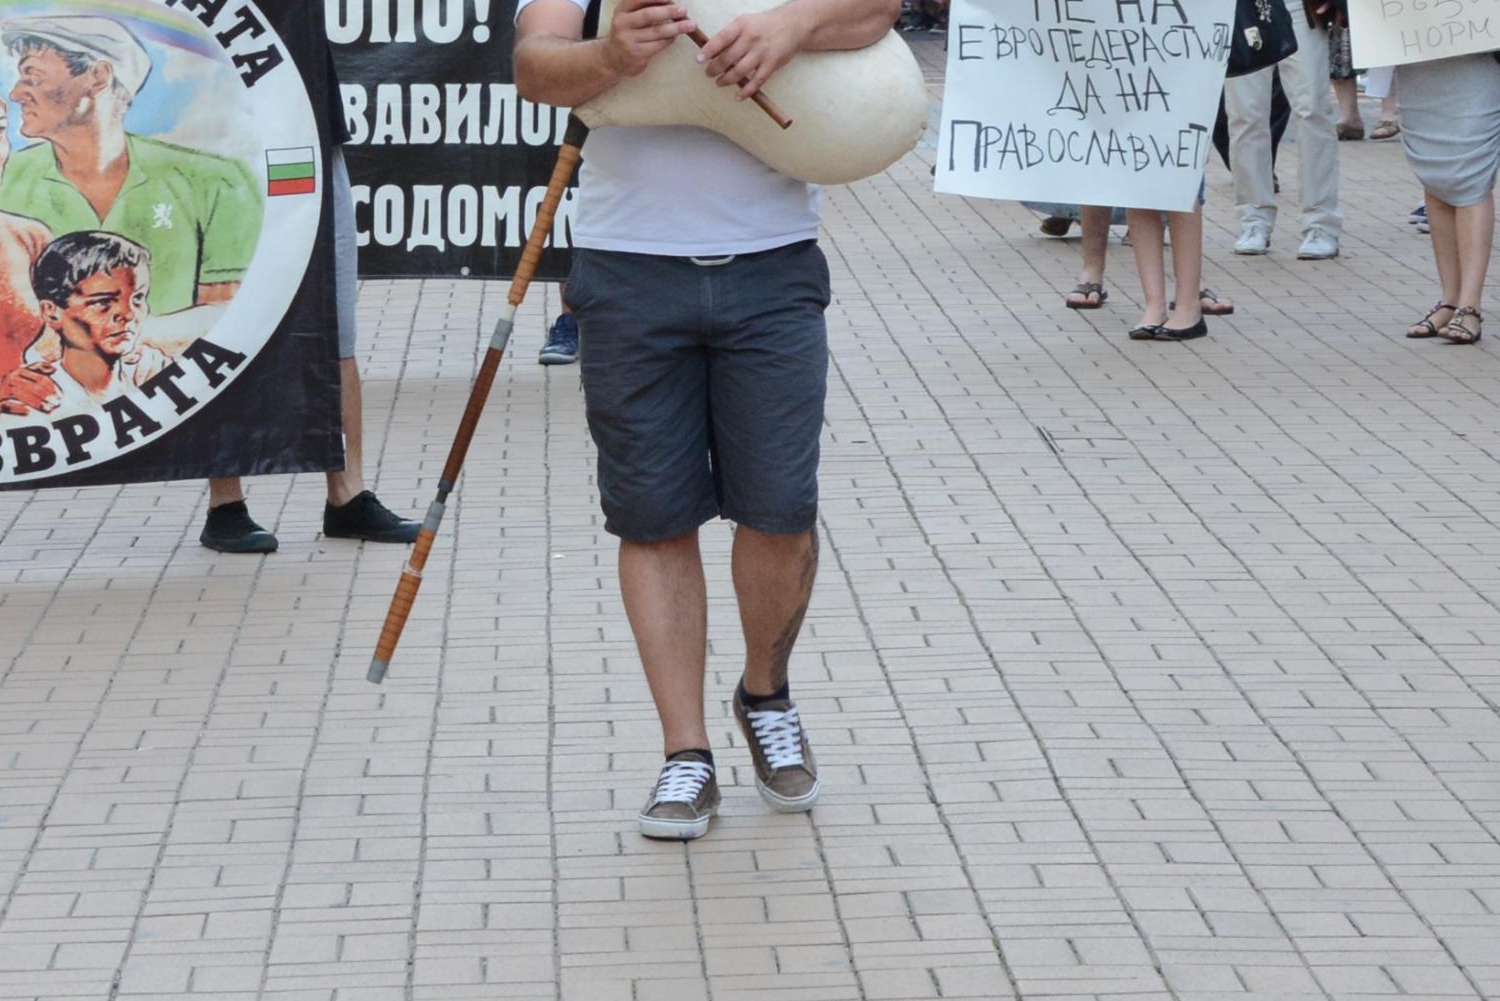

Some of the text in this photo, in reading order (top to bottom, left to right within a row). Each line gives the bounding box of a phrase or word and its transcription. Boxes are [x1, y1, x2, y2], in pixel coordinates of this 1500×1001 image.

[340, 83, 571, 145] ВАВИЛО
[1046, 66, 1170, 120] ДА НА
